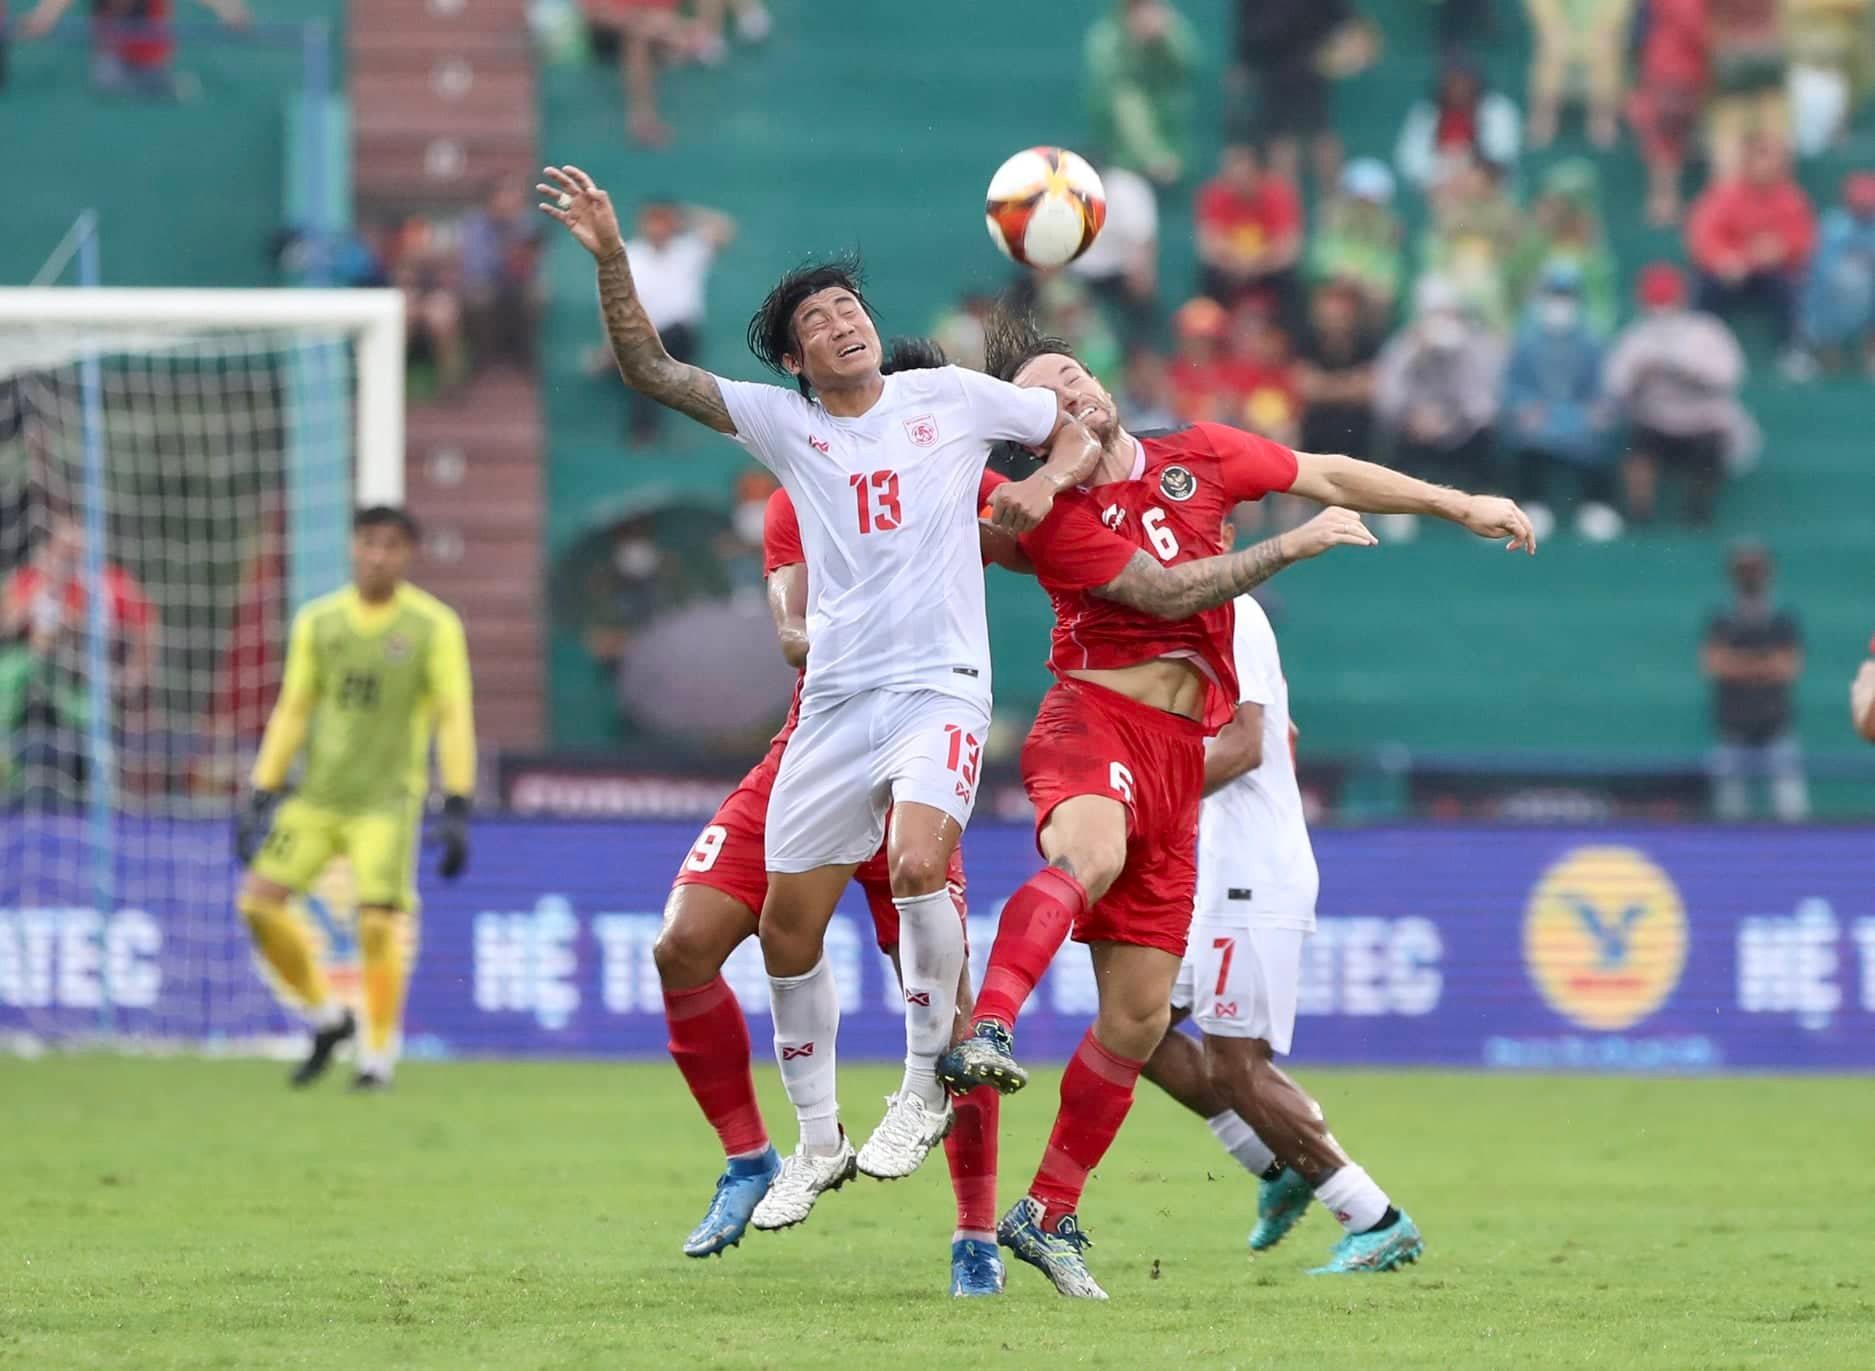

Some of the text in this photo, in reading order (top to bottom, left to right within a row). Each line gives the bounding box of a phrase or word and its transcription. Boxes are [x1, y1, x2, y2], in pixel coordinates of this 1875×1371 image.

[848, 469, 902, 535] 13
[1141, 506, 1180, 561] 6
[944, 724, 980, 787] 13
[1109, 761, 1134, 802] 6
[680, 824, 728, 873] 9
[472, 895, 580, 1030] HỆ
[1212, 937, 1235, 997] 7
[1736, 896, 1842, 1030] HỆ
